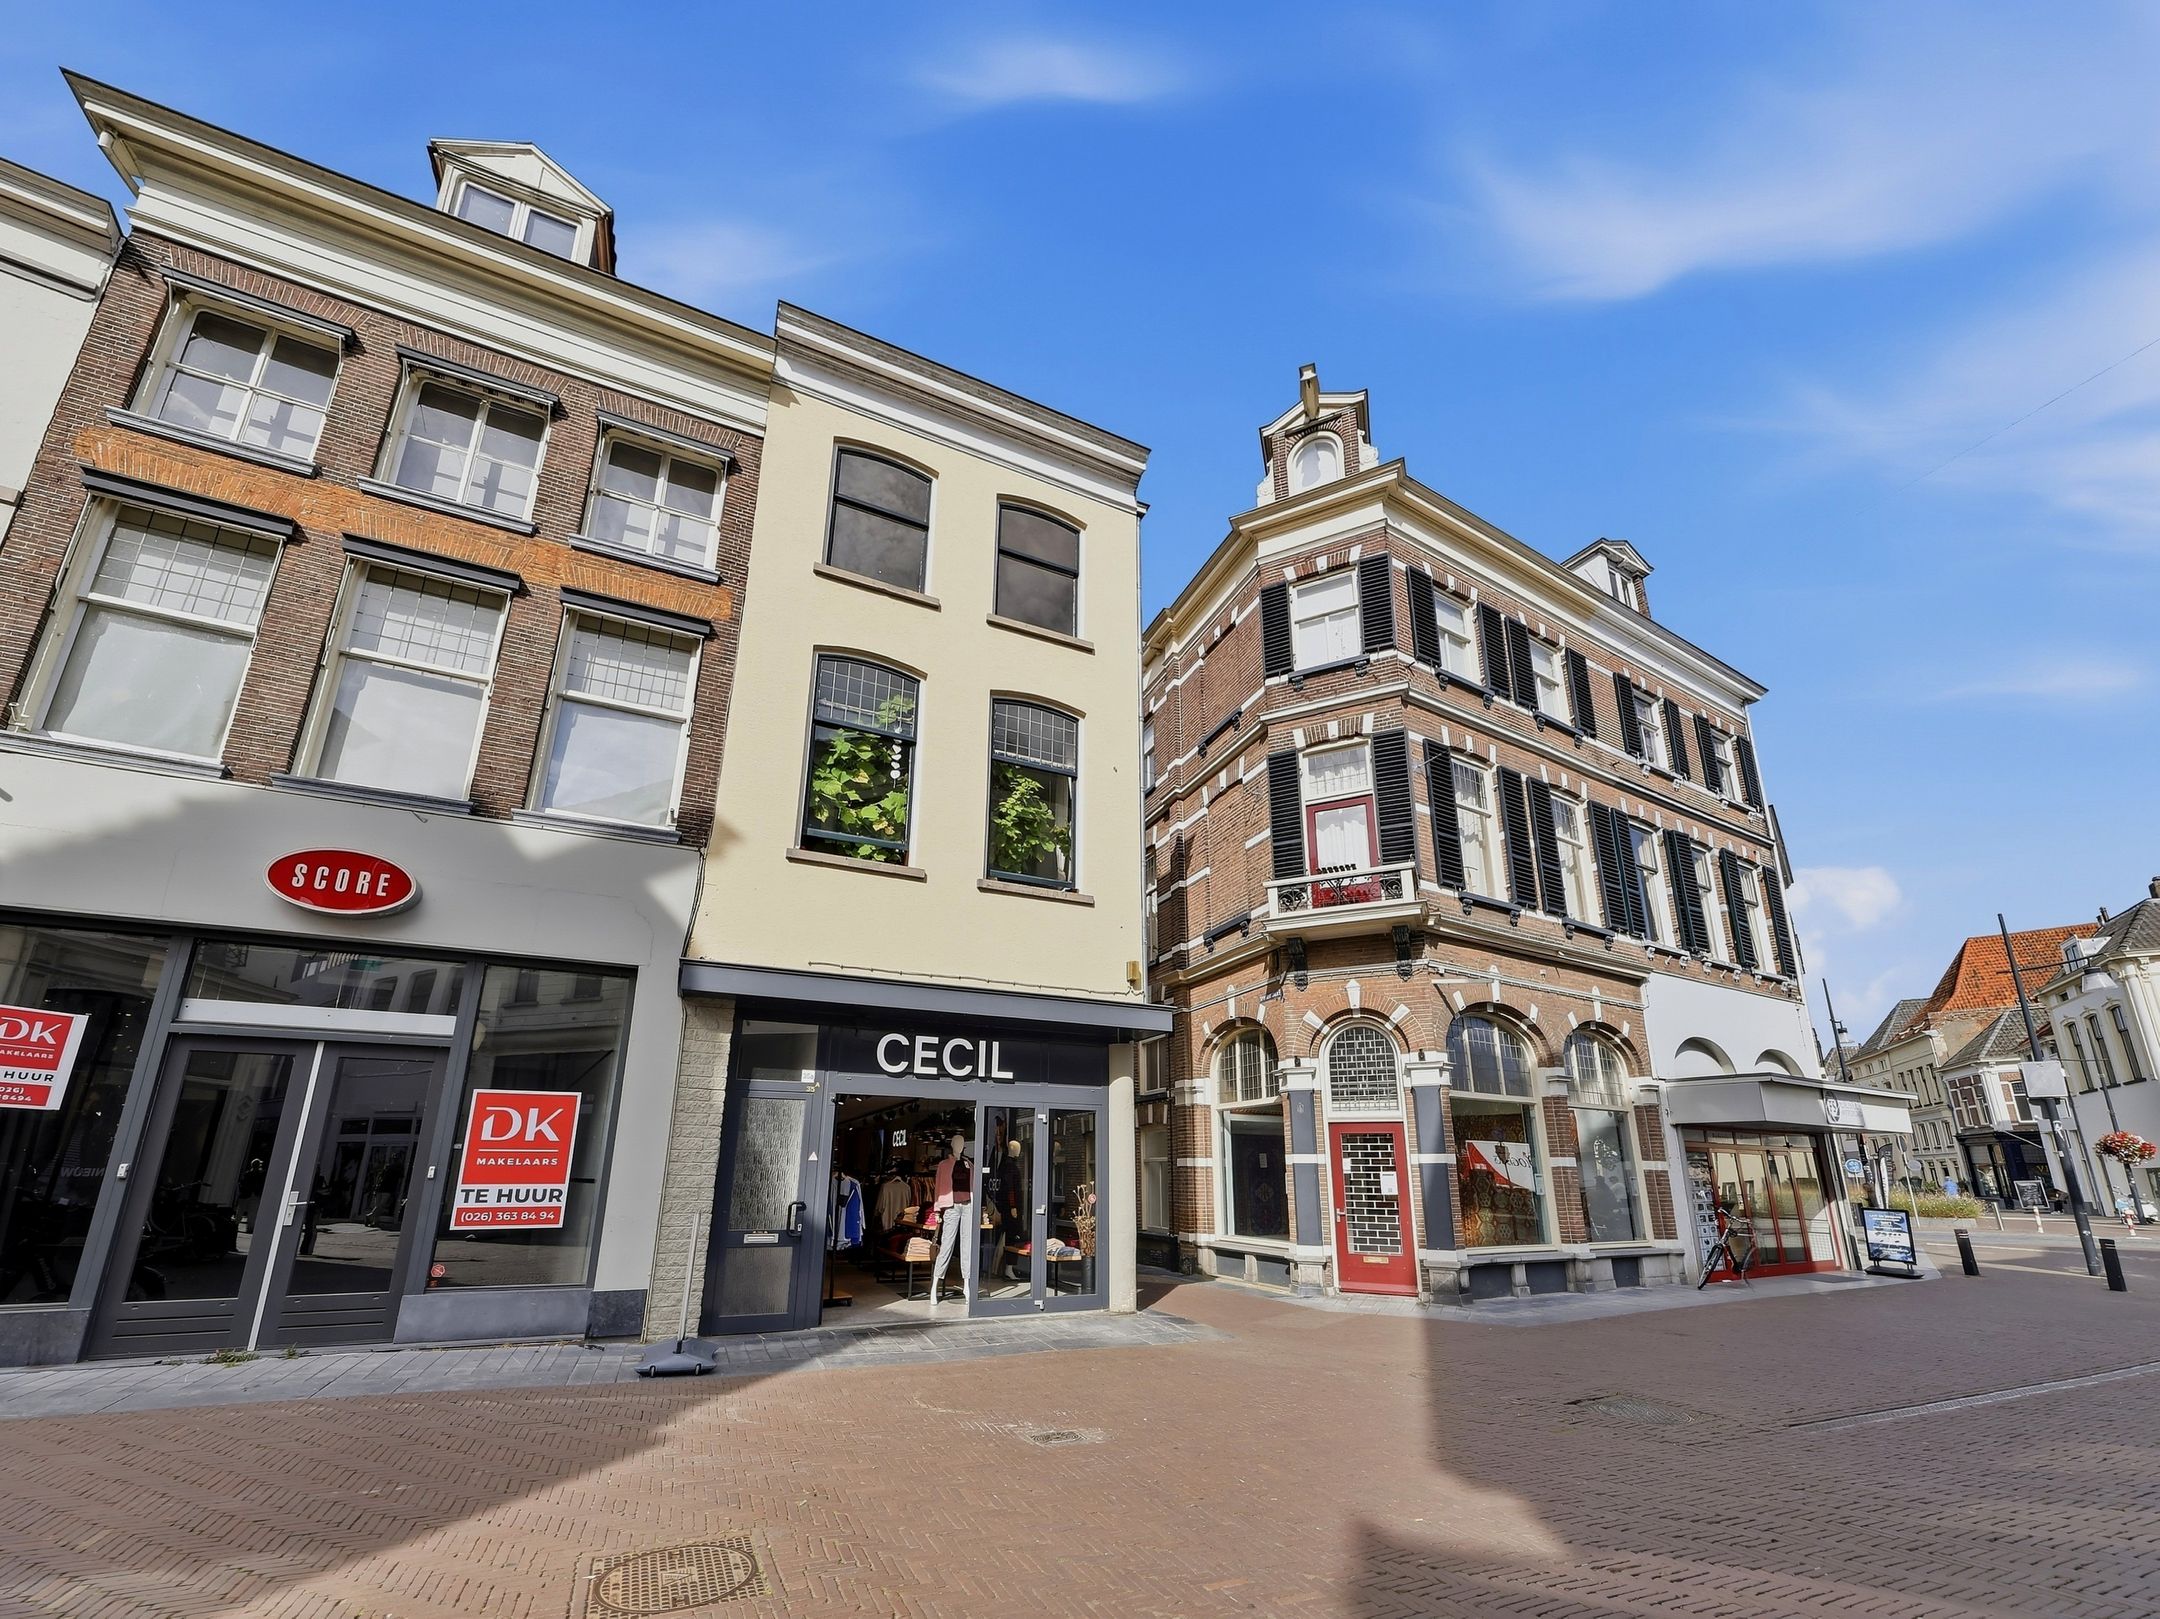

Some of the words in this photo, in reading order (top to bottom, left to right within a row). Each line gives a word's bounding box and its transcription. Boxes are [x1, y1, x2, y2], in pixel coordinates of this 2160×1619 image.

[291, 863, 391, 897] SCORE
[0, 1016, 62, 1045] DK
[0, 1049, 54, 1060] AKELAARS
[876, 1032, 1014, 1079] CECIL
[3, 1070, 55, 1082] HUUR
[0, 1086, 24, 1095] 026)
[481, 1106, 564, 1142] DK
[476, 1157, 559, 1166] MAKELAARS
[460, 1188, 490, 1204] TE
[496, 1188, 564, 1203] HUUR
[460, 1211, 493, 1223] (026)
[496, 1211, 518, 1221] 363
[521, 1211, 537, 1220] 84
[539, 1211, 555, 1220] 94
